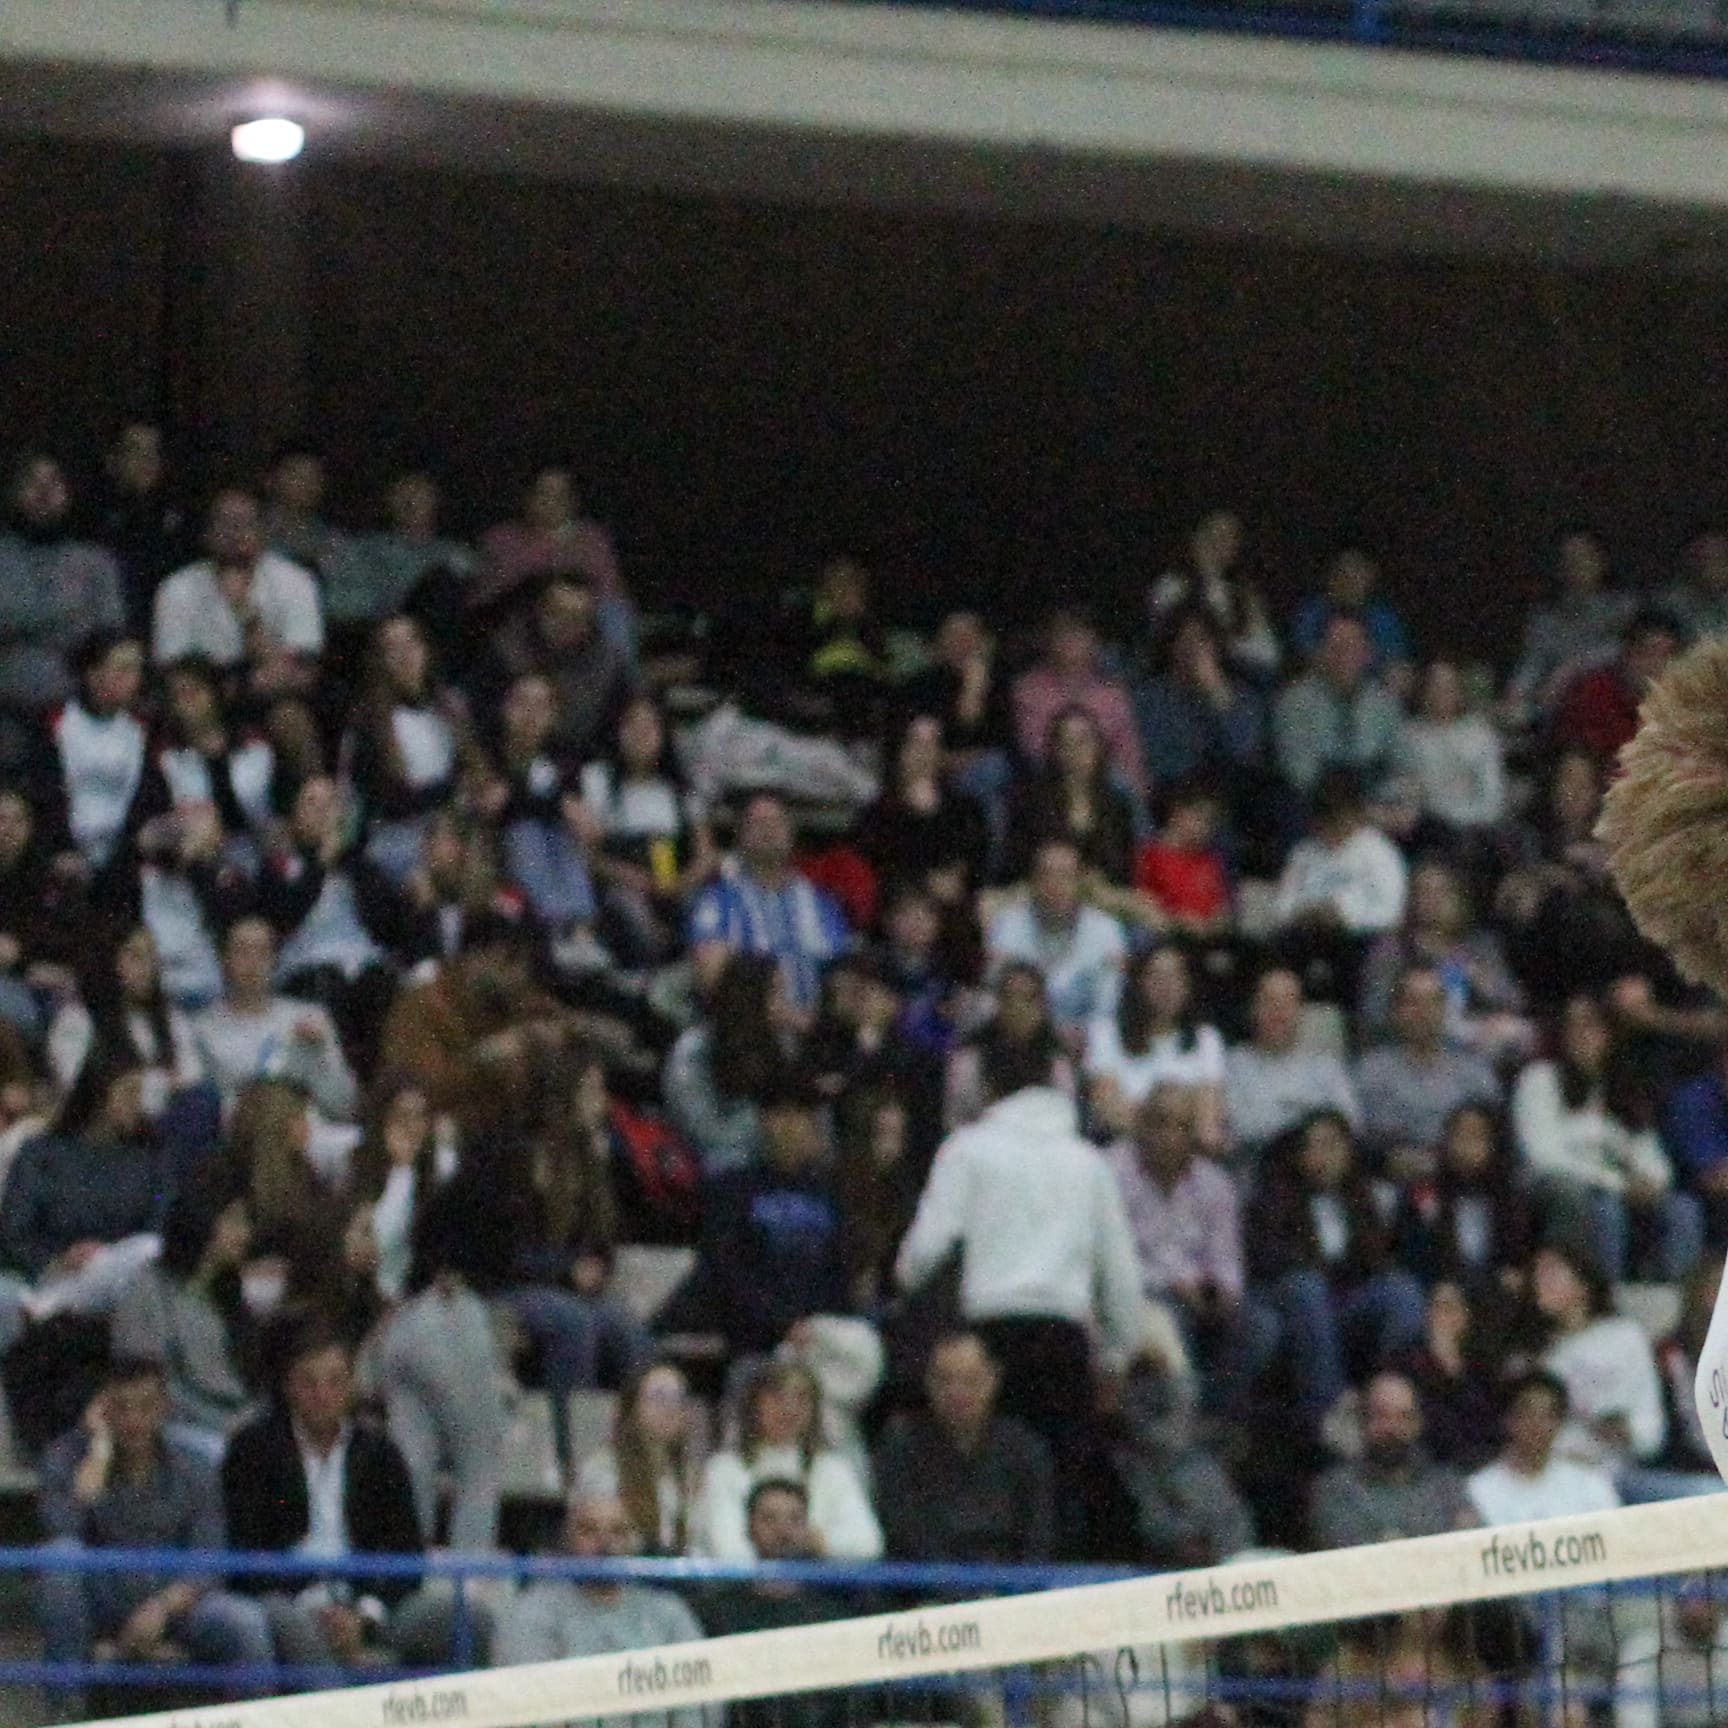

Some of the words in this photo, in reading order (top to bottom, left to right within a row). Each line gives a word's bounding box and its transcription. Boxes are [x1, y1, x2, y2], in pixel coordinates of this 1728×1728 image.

[1480, 1529, 1608, 1578] rfevb.com
[1165, 1577, 1279, 1622] rfevb.com
[877, 1620, 982, 1662] rfevb.com
[617, 1657, 713, 1696] rfevb.com
[382, 1688, 468, 1726] rfevb.com
